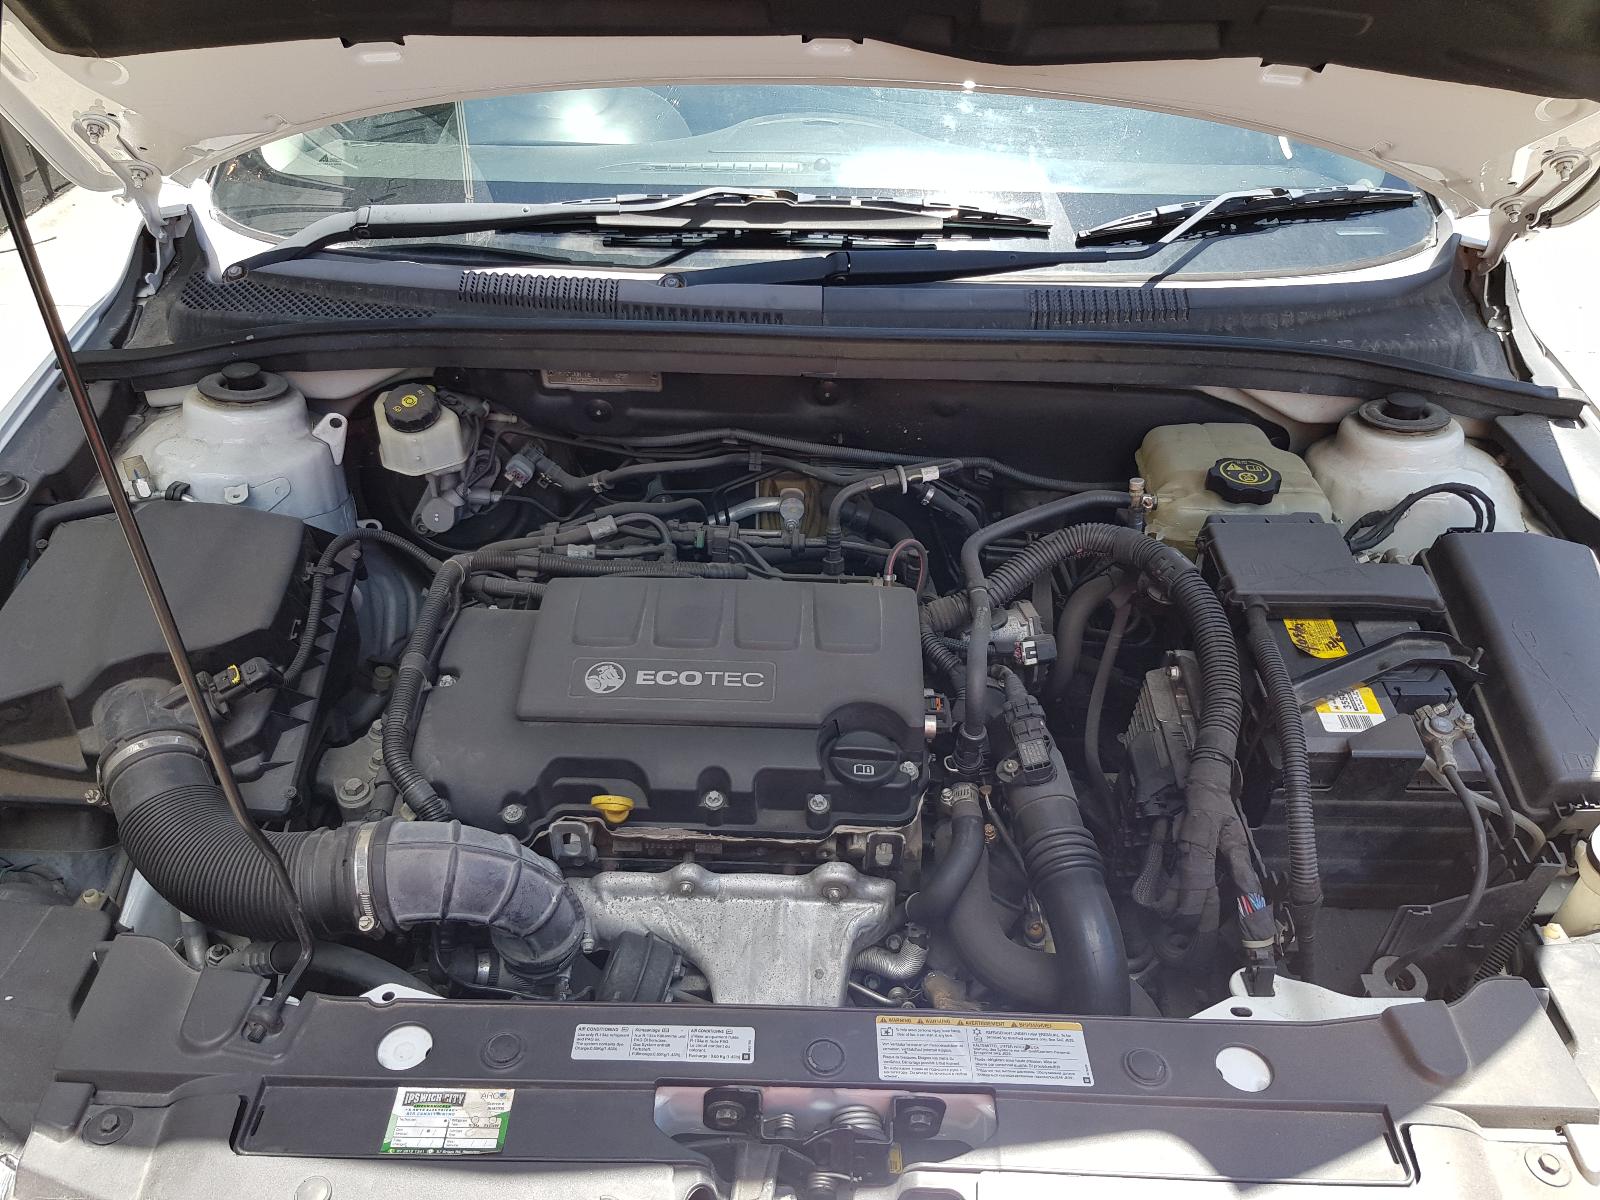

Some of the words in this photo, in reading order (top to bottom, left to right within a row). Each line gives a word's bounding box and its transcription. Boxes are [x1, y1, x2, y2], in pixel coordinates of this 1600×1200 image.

[636, 670, 765, 687] ECOTEC
[404, 1092, 443, 1104] IPSWICH
[443, 1092, 464, 1104] CITY
